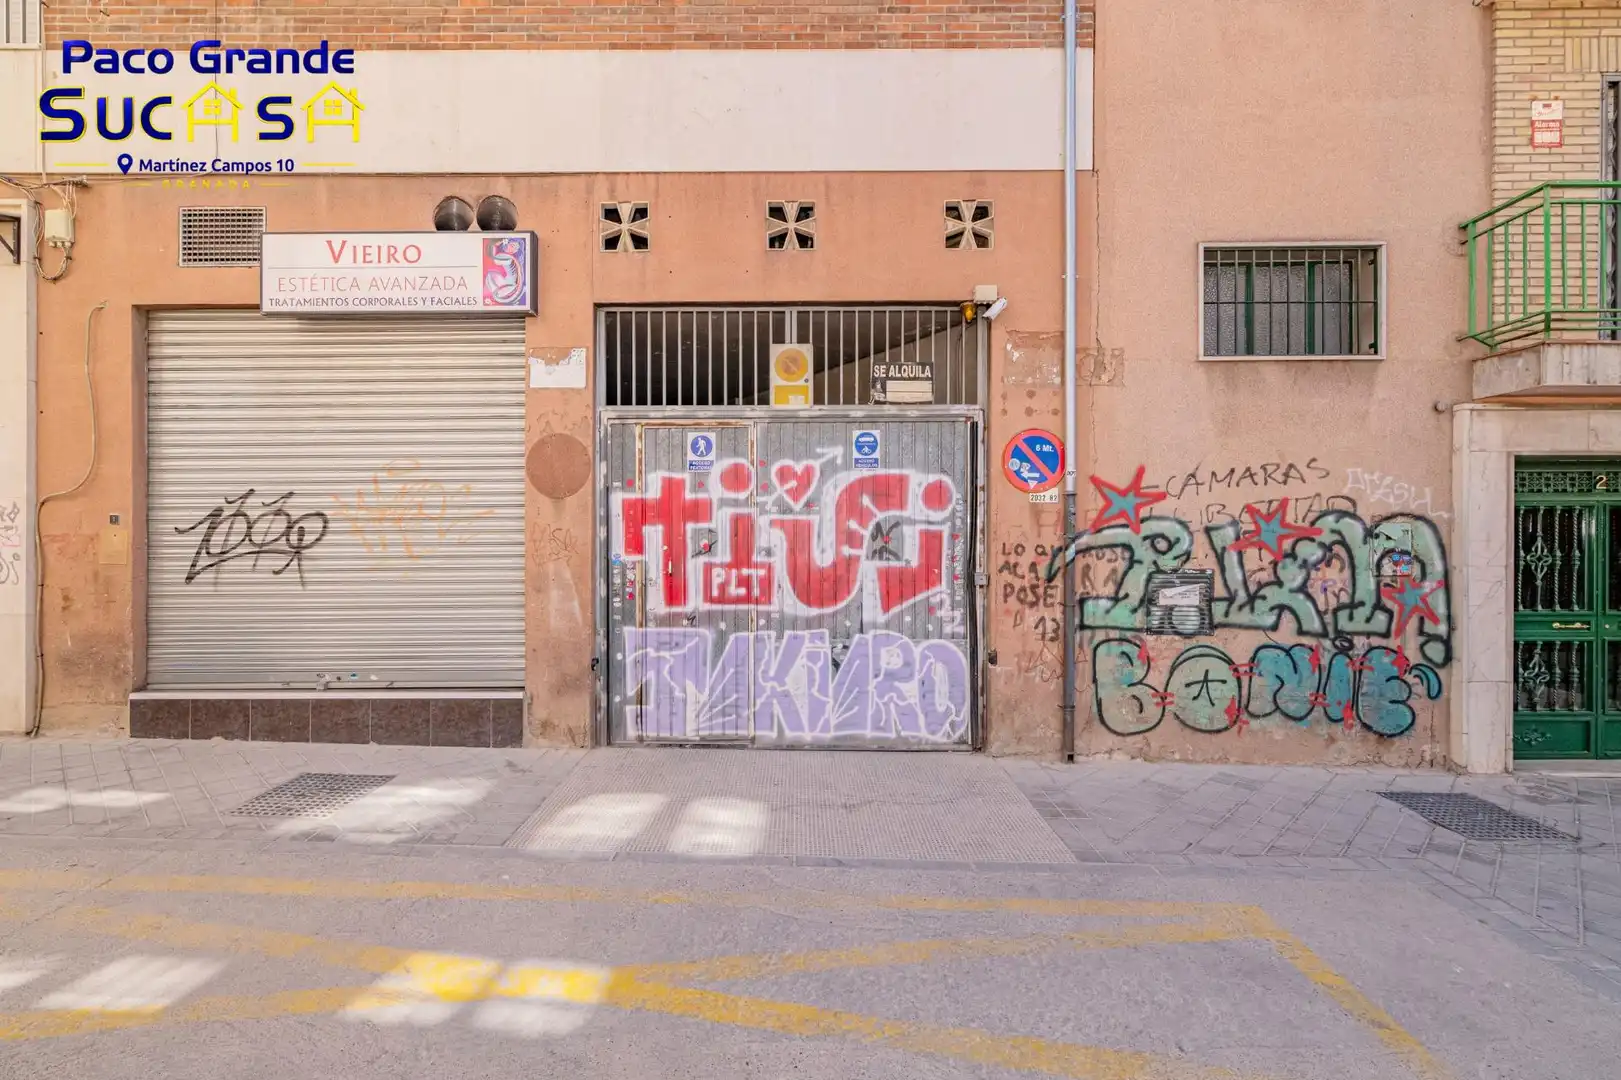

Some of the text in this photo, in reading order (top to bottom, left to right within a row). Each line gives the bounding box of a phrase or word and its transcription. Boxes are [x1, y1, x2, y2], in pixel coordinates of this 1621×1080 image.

[278, 273, 468, 293] ESTÉTICA AVANZADA
[269, 296, 478, 308] TRATAMIENTOS CORPORALES Y FACIALES
[873, 364, 932, 378] SE ALQUILA
[1595, 475, 1607, 489] 2
[711, 566, 766, 597] PLT
